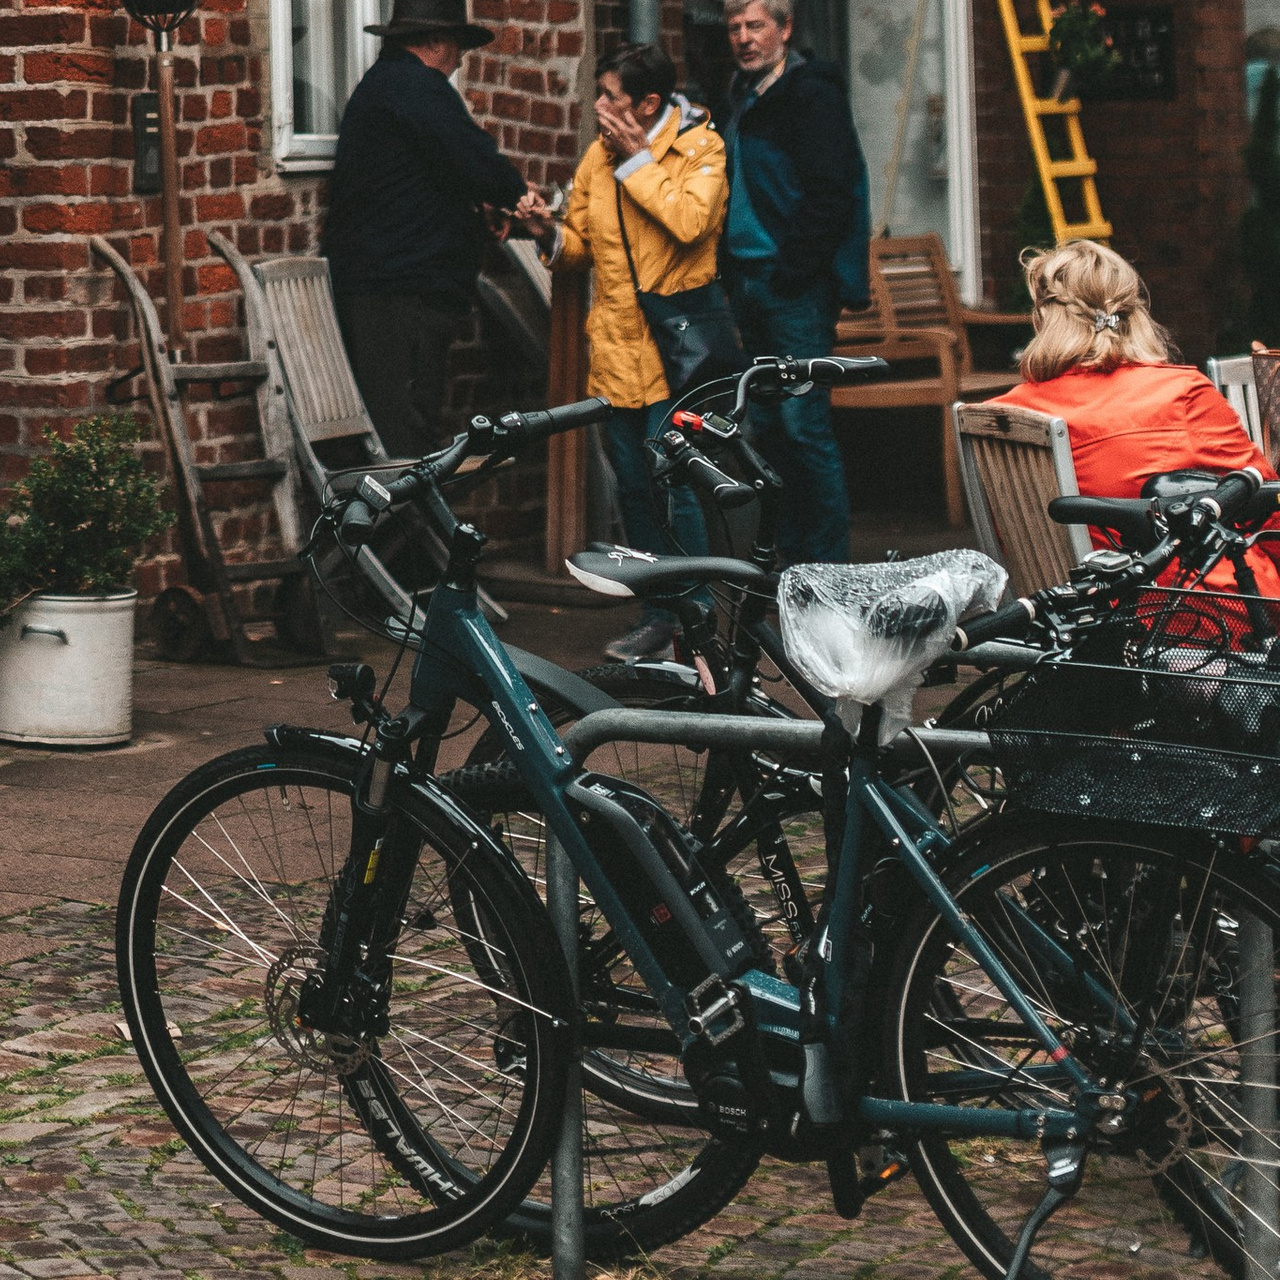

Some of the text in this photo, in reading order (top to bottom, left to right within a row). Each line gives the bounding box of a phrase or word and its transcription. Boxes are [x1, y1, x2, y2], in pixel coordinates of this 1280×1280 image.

[491, 701, 524, 750] BICYCLES
[765, 853, 799, 920] MISS
[356, 1079, 466, 1201] CHWALBE
[719, 1105, 748, 1117] BOSCH
